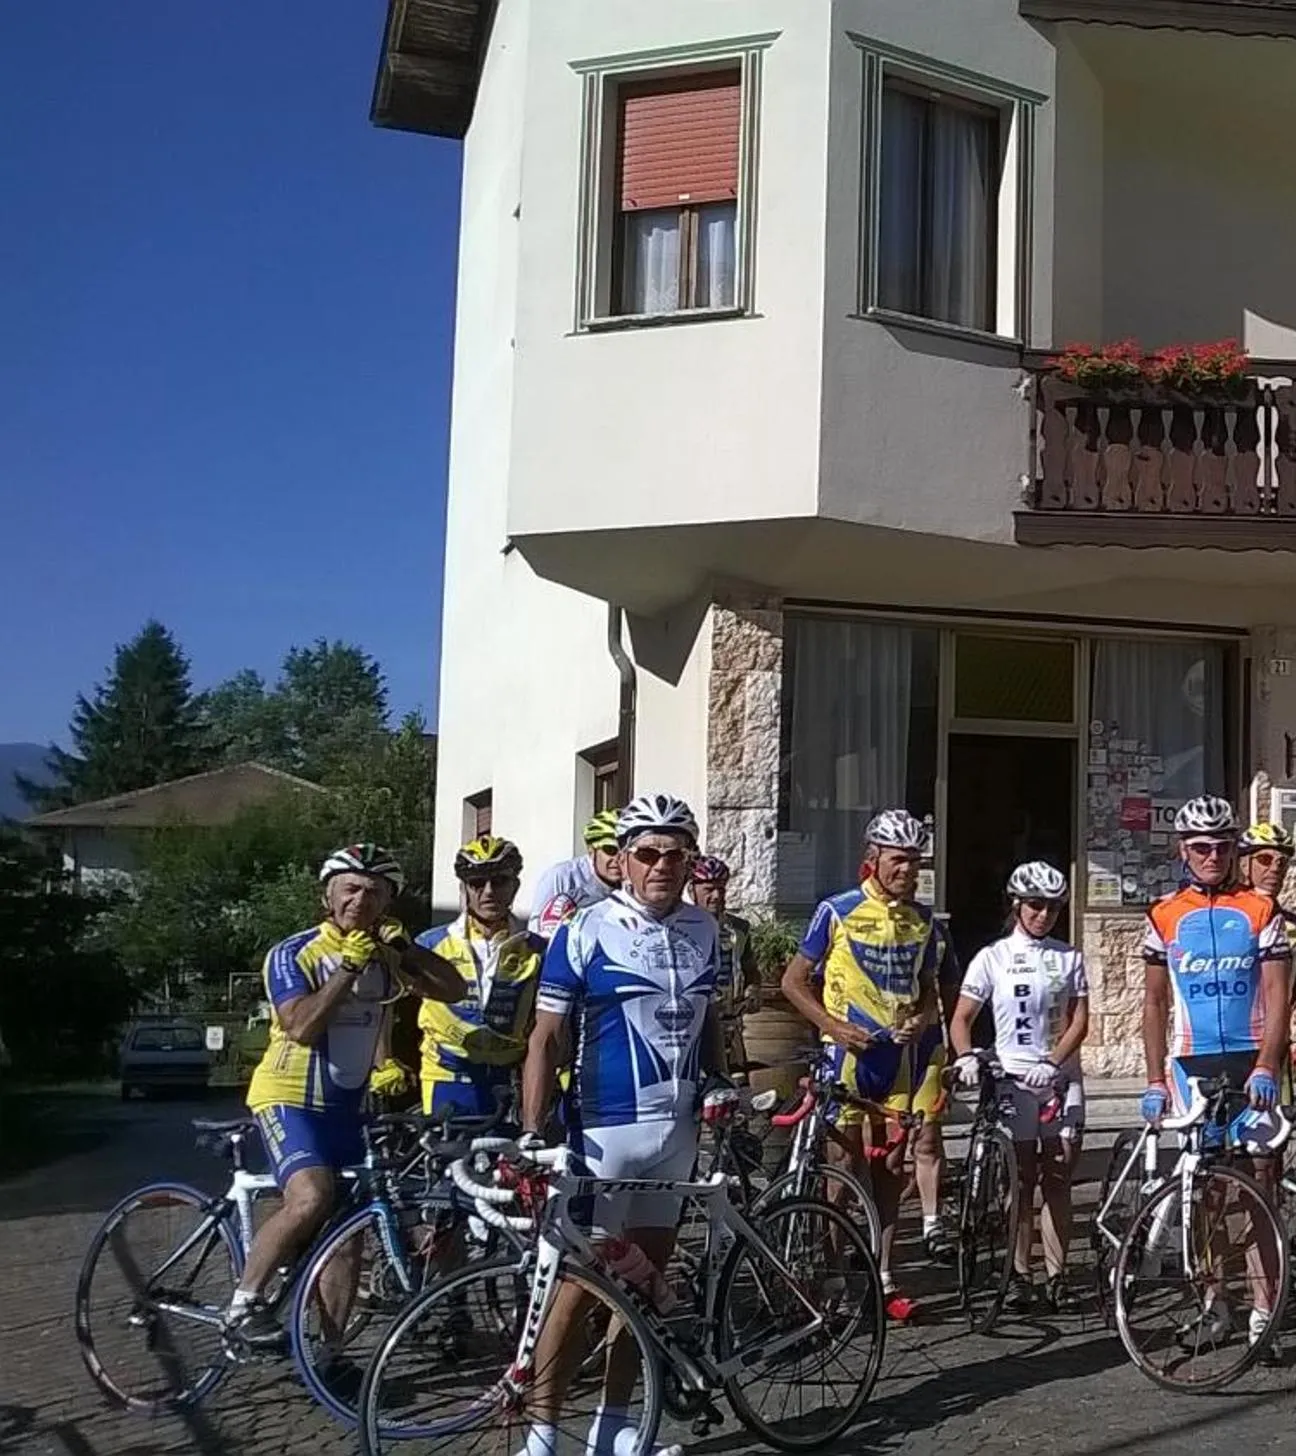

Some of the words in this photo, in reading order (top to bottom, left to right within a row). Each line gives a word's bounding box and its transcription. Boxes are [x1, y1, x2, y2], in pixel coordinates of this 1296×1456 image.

[1189, 980, 1248, 999] POLO
[1013, 984, 1035, 1046] BIKE
[602, 1181, 675, 1193] TREK
